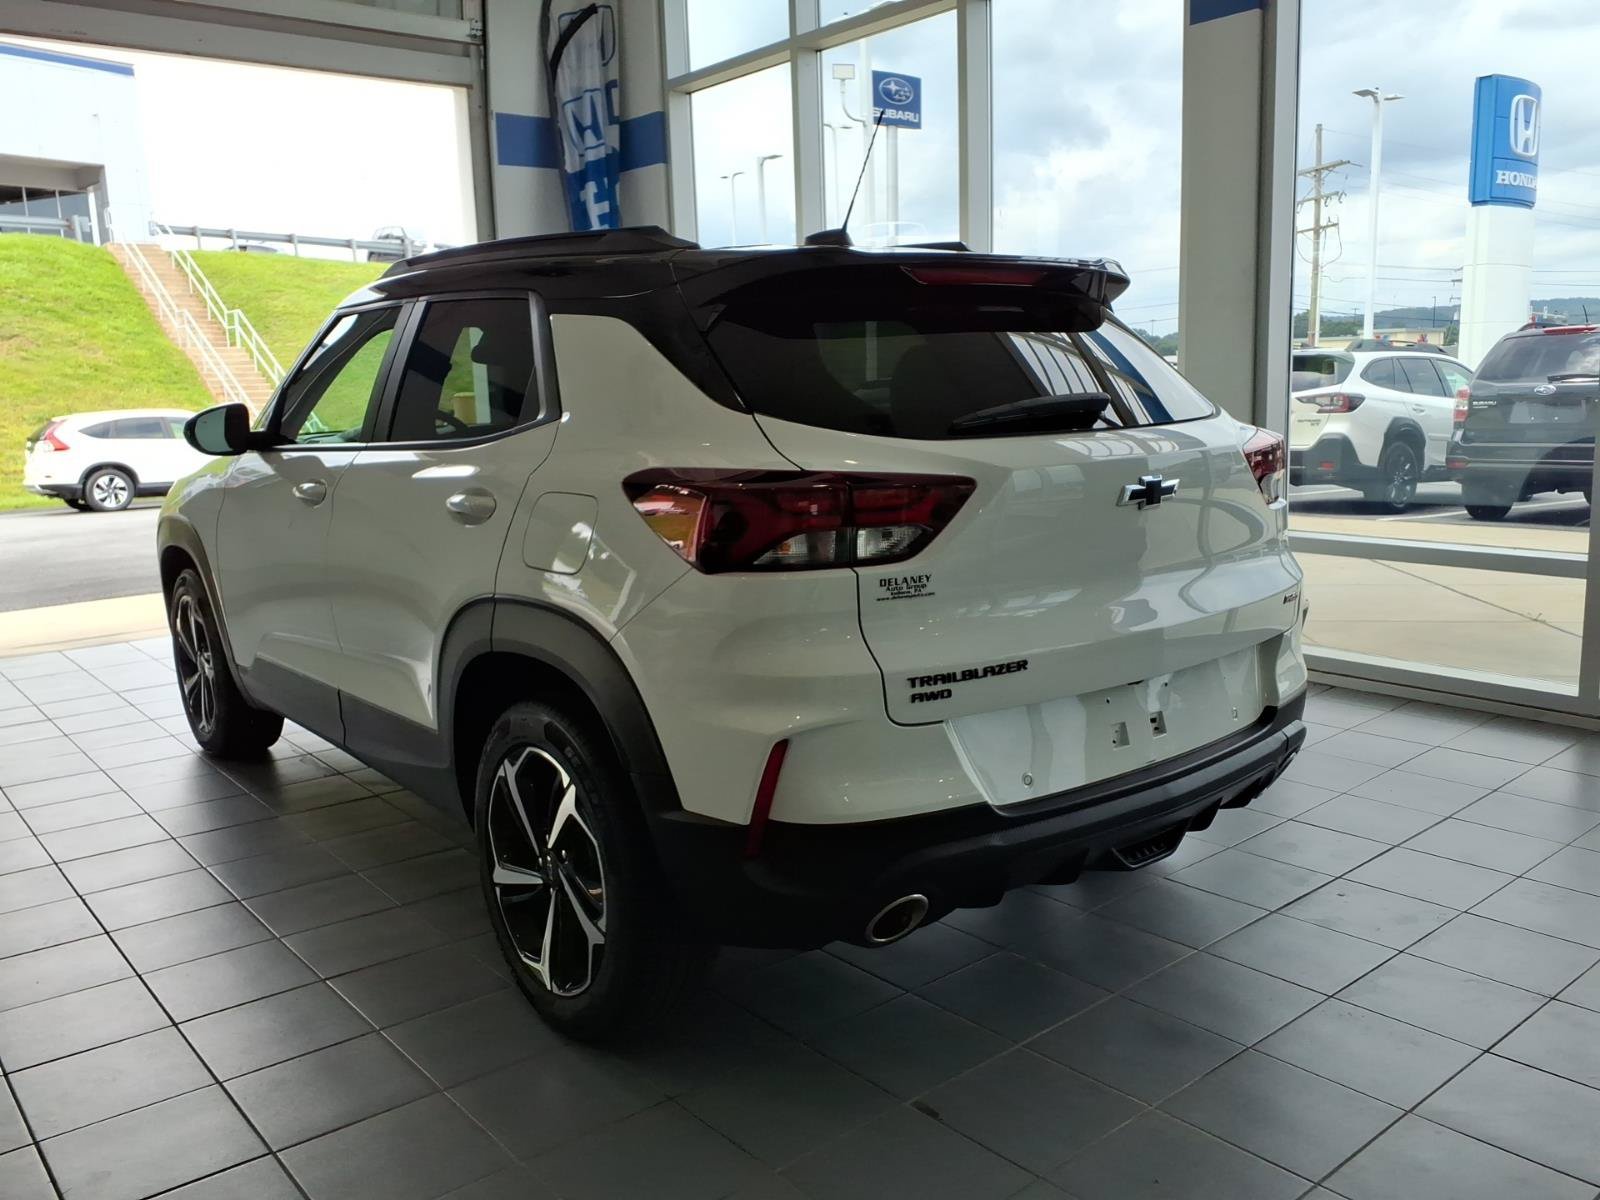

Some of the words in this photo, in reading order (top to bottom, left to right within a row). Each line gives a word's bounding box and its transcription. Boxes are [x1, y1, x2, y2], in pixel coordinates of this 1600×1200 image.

[879, 574, 932, 587] DELANEY
[906, 583, 927, 591] Group
[907, 659, 1029, 688] TRAILBLAZER
[910, 689, 952, 703] AWD
